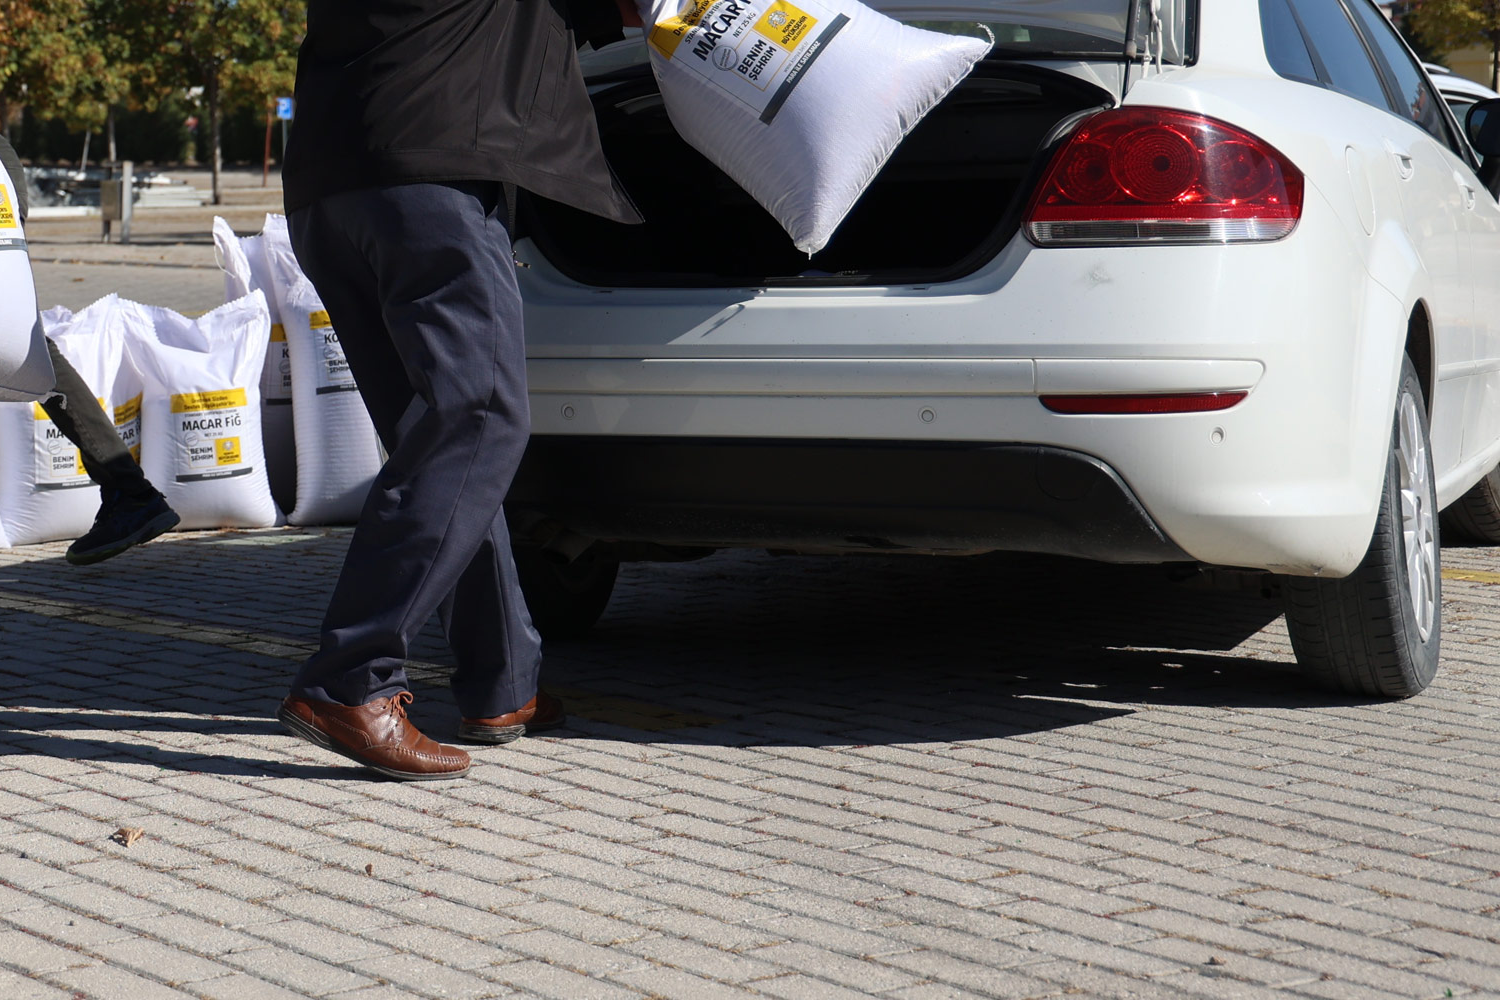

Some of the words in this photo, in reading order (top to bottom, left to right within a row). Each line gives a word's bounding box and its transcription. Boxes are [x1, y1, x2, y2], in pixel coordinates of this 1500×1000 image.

[691, 2, 743, 61] MACAR
[732, 25, 744, 38] NET
[741, 18, 749, 27] 25
[746, 10, 756, 21] KG
[182, 418, 222, 431] MACAR
